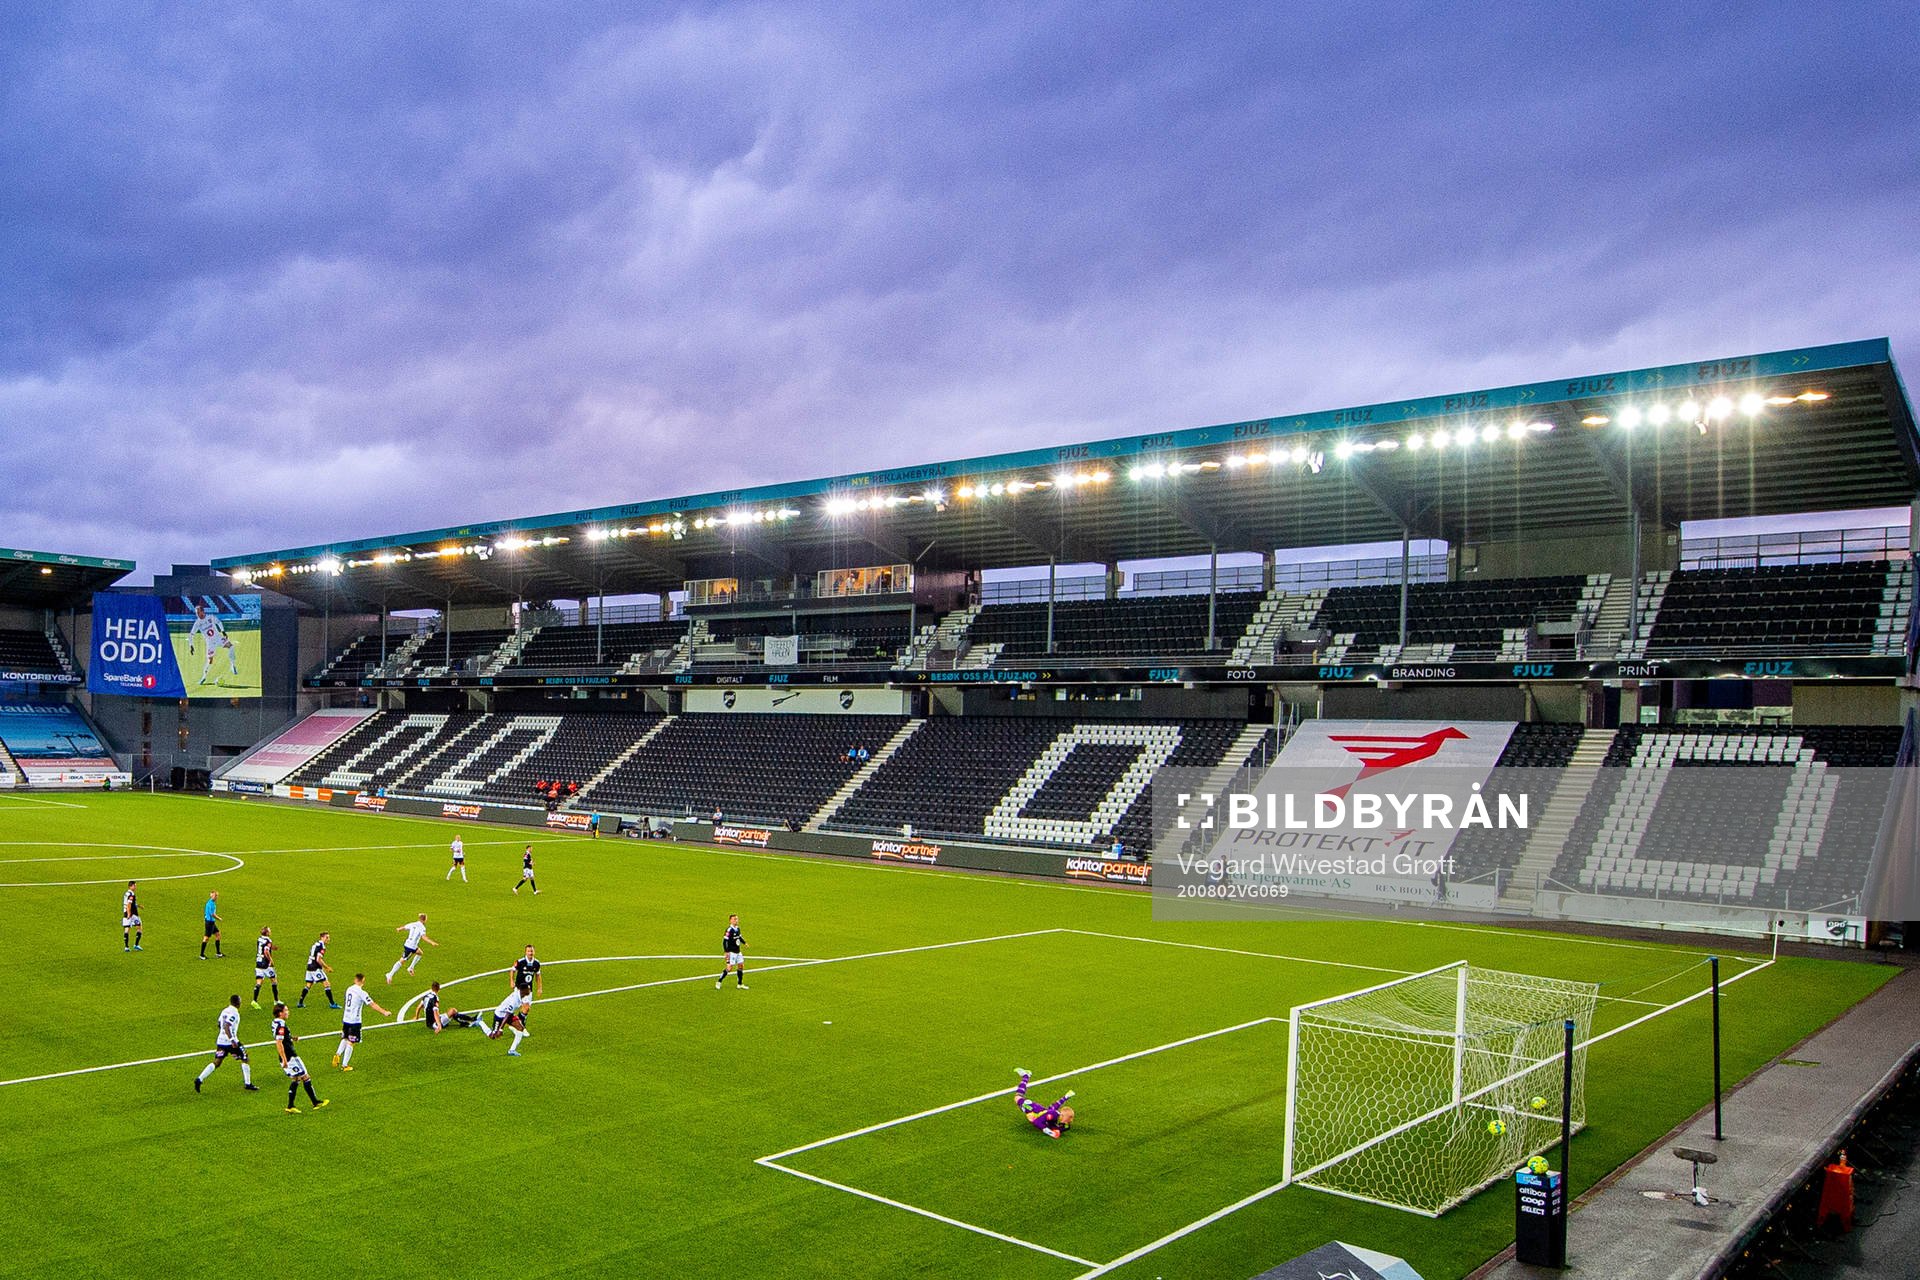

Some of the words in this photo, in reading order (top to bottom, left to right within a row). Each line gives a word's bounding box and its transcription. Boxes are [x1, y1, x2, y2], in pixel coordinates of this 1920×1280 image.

[1567, 377, 1616, 395] FJUZ
[1234, 422, 1269, 437] FJUZ
[1141, 435, 1174, 449] FJUZ
[1058, 446, 1089, 460] FJUZ
[851, 476, 870, 486] NYE
[105, 617, 160, 640] HEIA
[100, 640, 162, 664] ODD!
[1319, 667, 1354, 678] FJUZ
[1392, 668, 1456, 678] BRANDING
[1512, 664, 1554, 677] FJUZ
[1618, 666, 1660, 675] PRINT
[1744, 661, 1793, 675] FJUZ
[103, 673, 143, 683] SpareBank
[675, 676, 693, 684] FJUZ
[716, 676, 743, 684] DIGITALT
[768, 674, 789, 683] FJUZ
[823, 675, 839, 683] FILM
[931, 672, 960, 681] BESØK
[963, 672, 981, 681] OSS
[982, 670, 995, 680] PÅ
[998, 672, 1037, 680] FJUZ.NO
[1149, 669, 1179, 680] FJUZ
[1227, 670, 1256, 679] FOTO
[714, 826, 772, 840] kontorpartner
[872, 840, 942, 856] kontorpartner
[1233, 829, 1383, 853] PROTEKT
[1399, 840, 1435, 857] IT
[1066, 857, 1152, 876] kontorpartner
[1331, 877, 1351, 889] AS
[1375, 884, 1396, 893] REN
[1519, 1187, 1547, 1198] altibox
[1521, 1196, 1545, 1206] coop
[1521, 1205, 1545, 1216] SELECT
